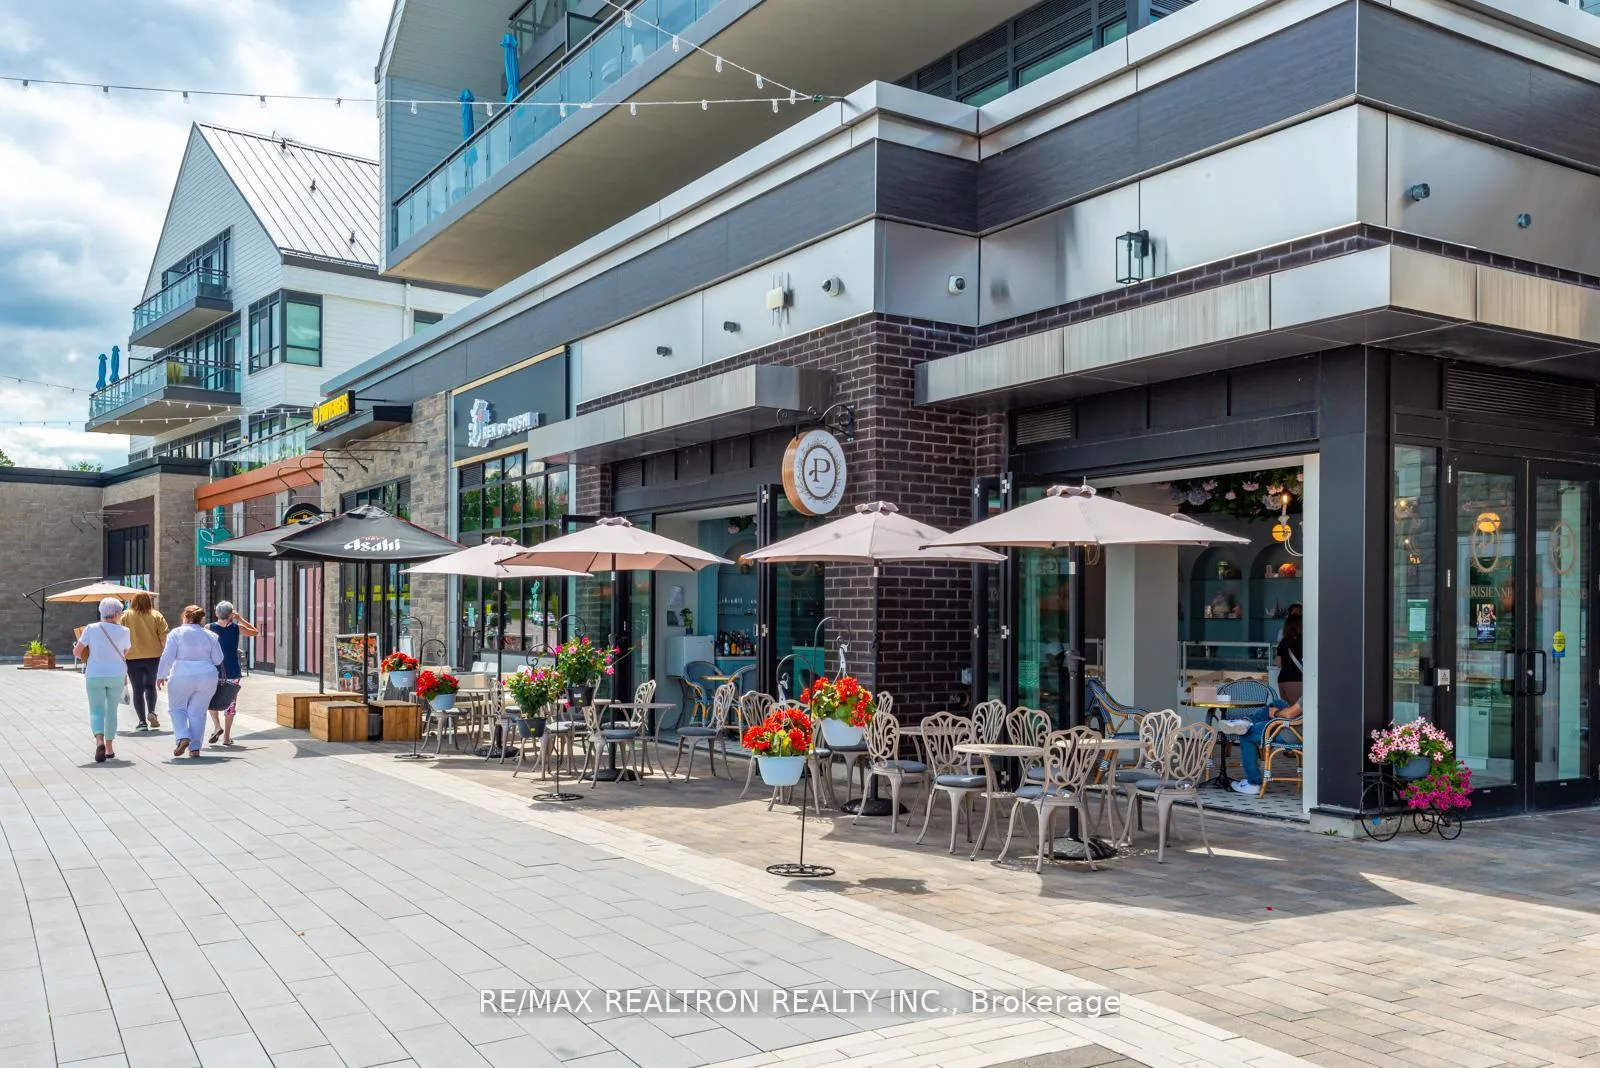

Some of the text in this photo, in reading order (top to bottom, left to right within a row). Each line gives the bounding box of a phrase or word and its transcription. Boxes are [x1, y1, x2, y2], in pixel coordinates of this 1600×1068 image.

[808, 457, 830, 483] P
[343, 538, 401, 552] Asahi
[1460, 585, 1513, 599] ARISIENNE
